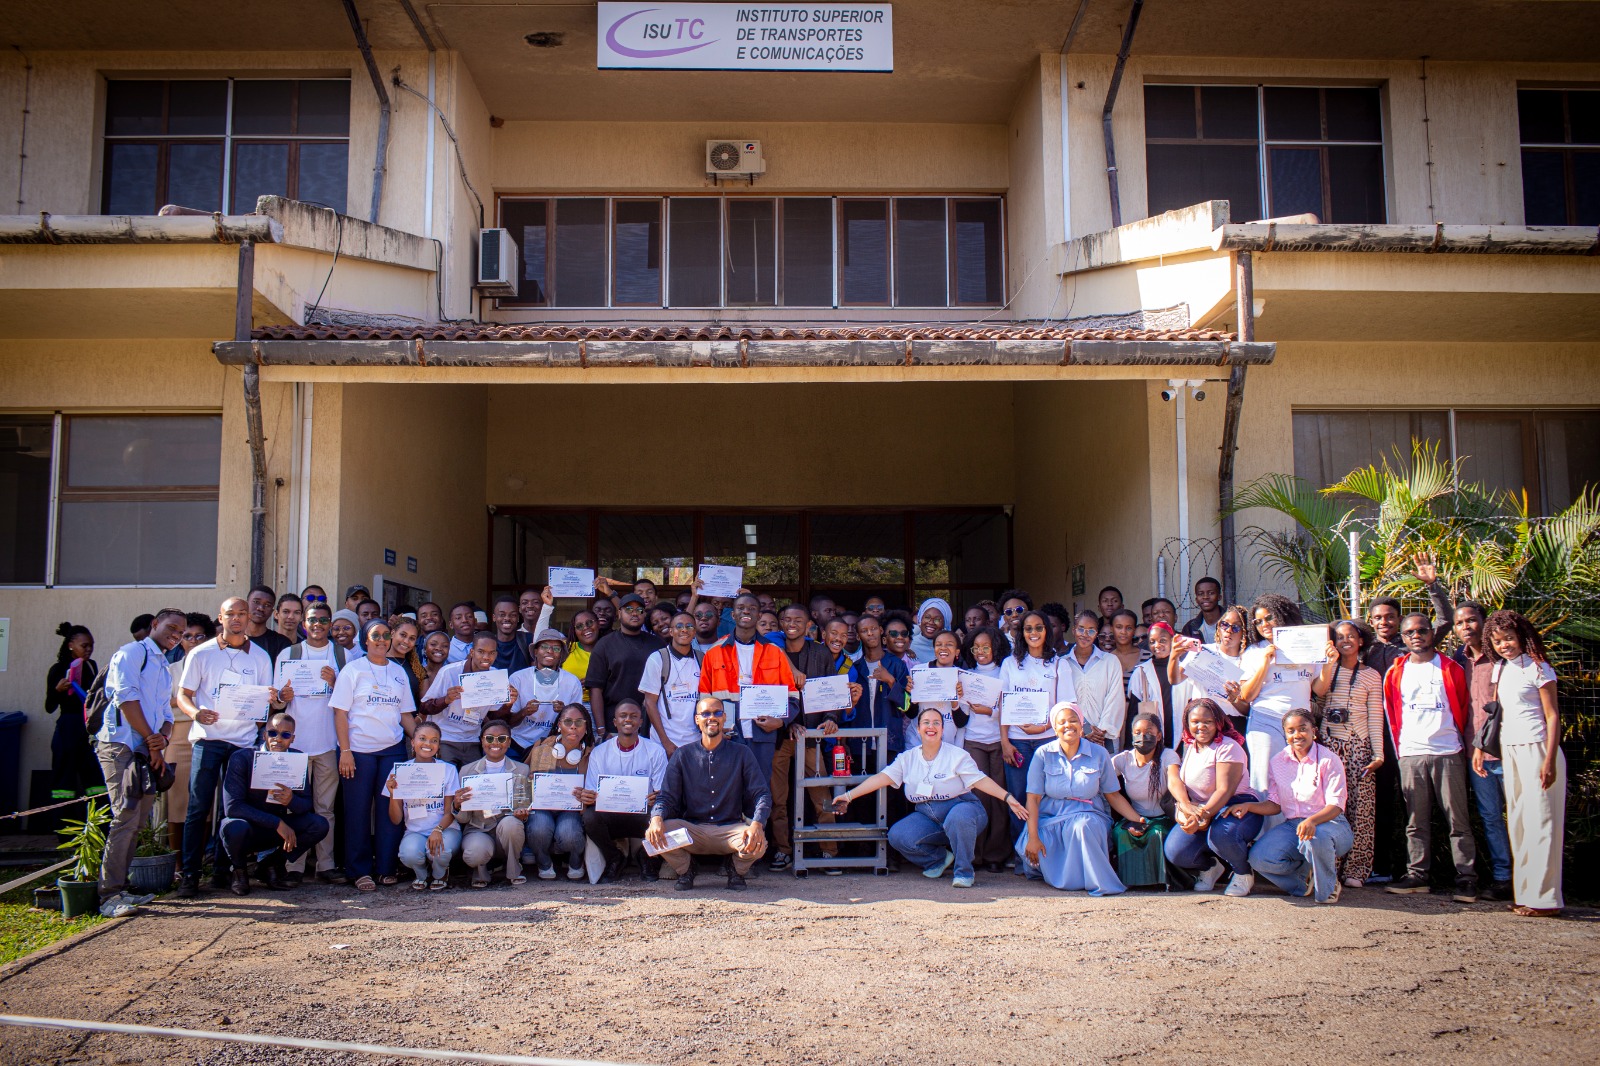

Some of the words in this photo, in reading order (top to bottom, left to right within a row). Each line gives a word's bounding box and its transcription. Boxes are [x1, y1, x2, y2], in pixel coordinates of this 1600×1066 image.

[736, 9, 809, 23] INSTITUTO
[812, 9, 884, 24] SUPERIOR
[736, 28, 756, 41] DE
[761, 28, 863, 42] TRANSPORTES
[737, 46, 746, 60] E
[750, 44, 864, 63] COMUNICAÇÕES
